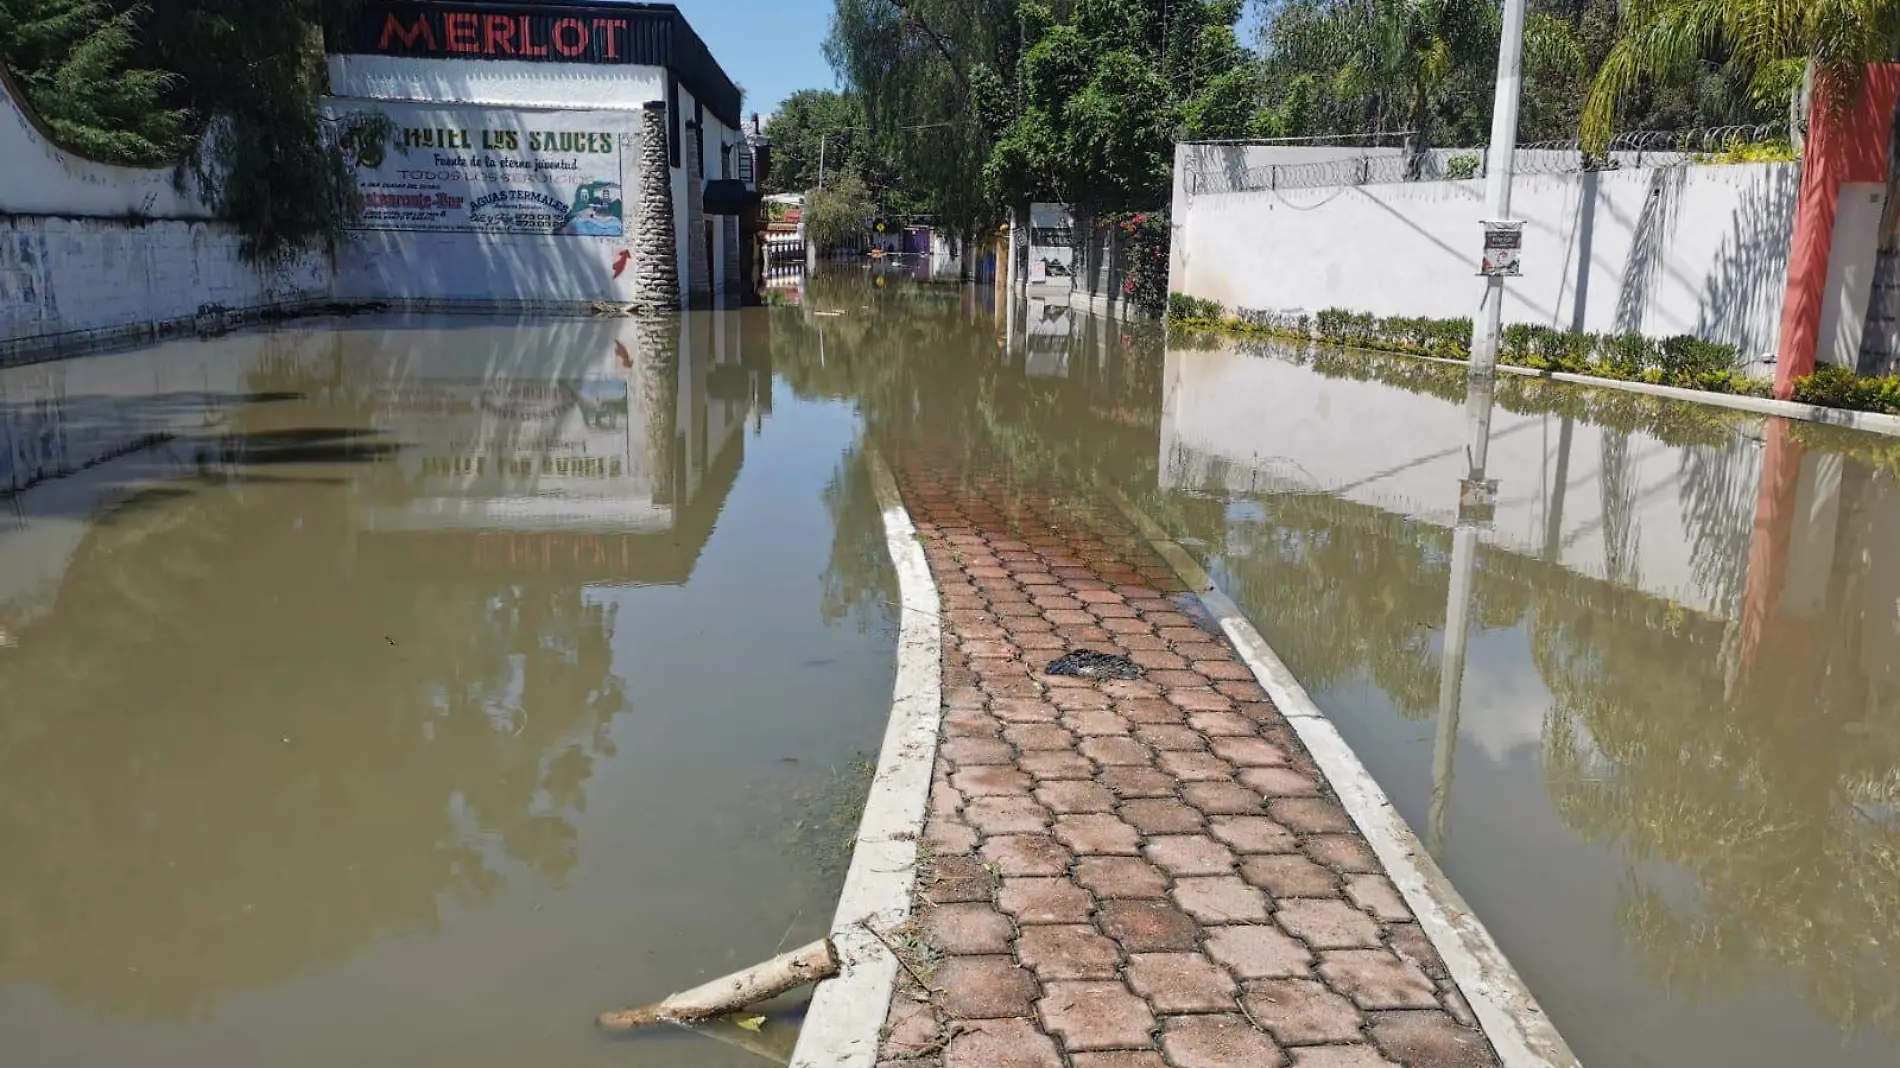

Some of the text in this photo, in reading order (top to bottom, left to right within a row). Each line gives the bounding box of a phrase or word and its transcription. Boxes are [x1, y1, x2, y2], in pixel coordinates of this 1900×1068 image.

[378, 13, 626, 58] MERLOT
[404, 128, 612, 153] HOTEL LOS SAUCES
[470, 155, 481, 168] de
[397, 170, 460, 181] TODOS
[470, 189, 569, 214] AGUAS TERMALES
